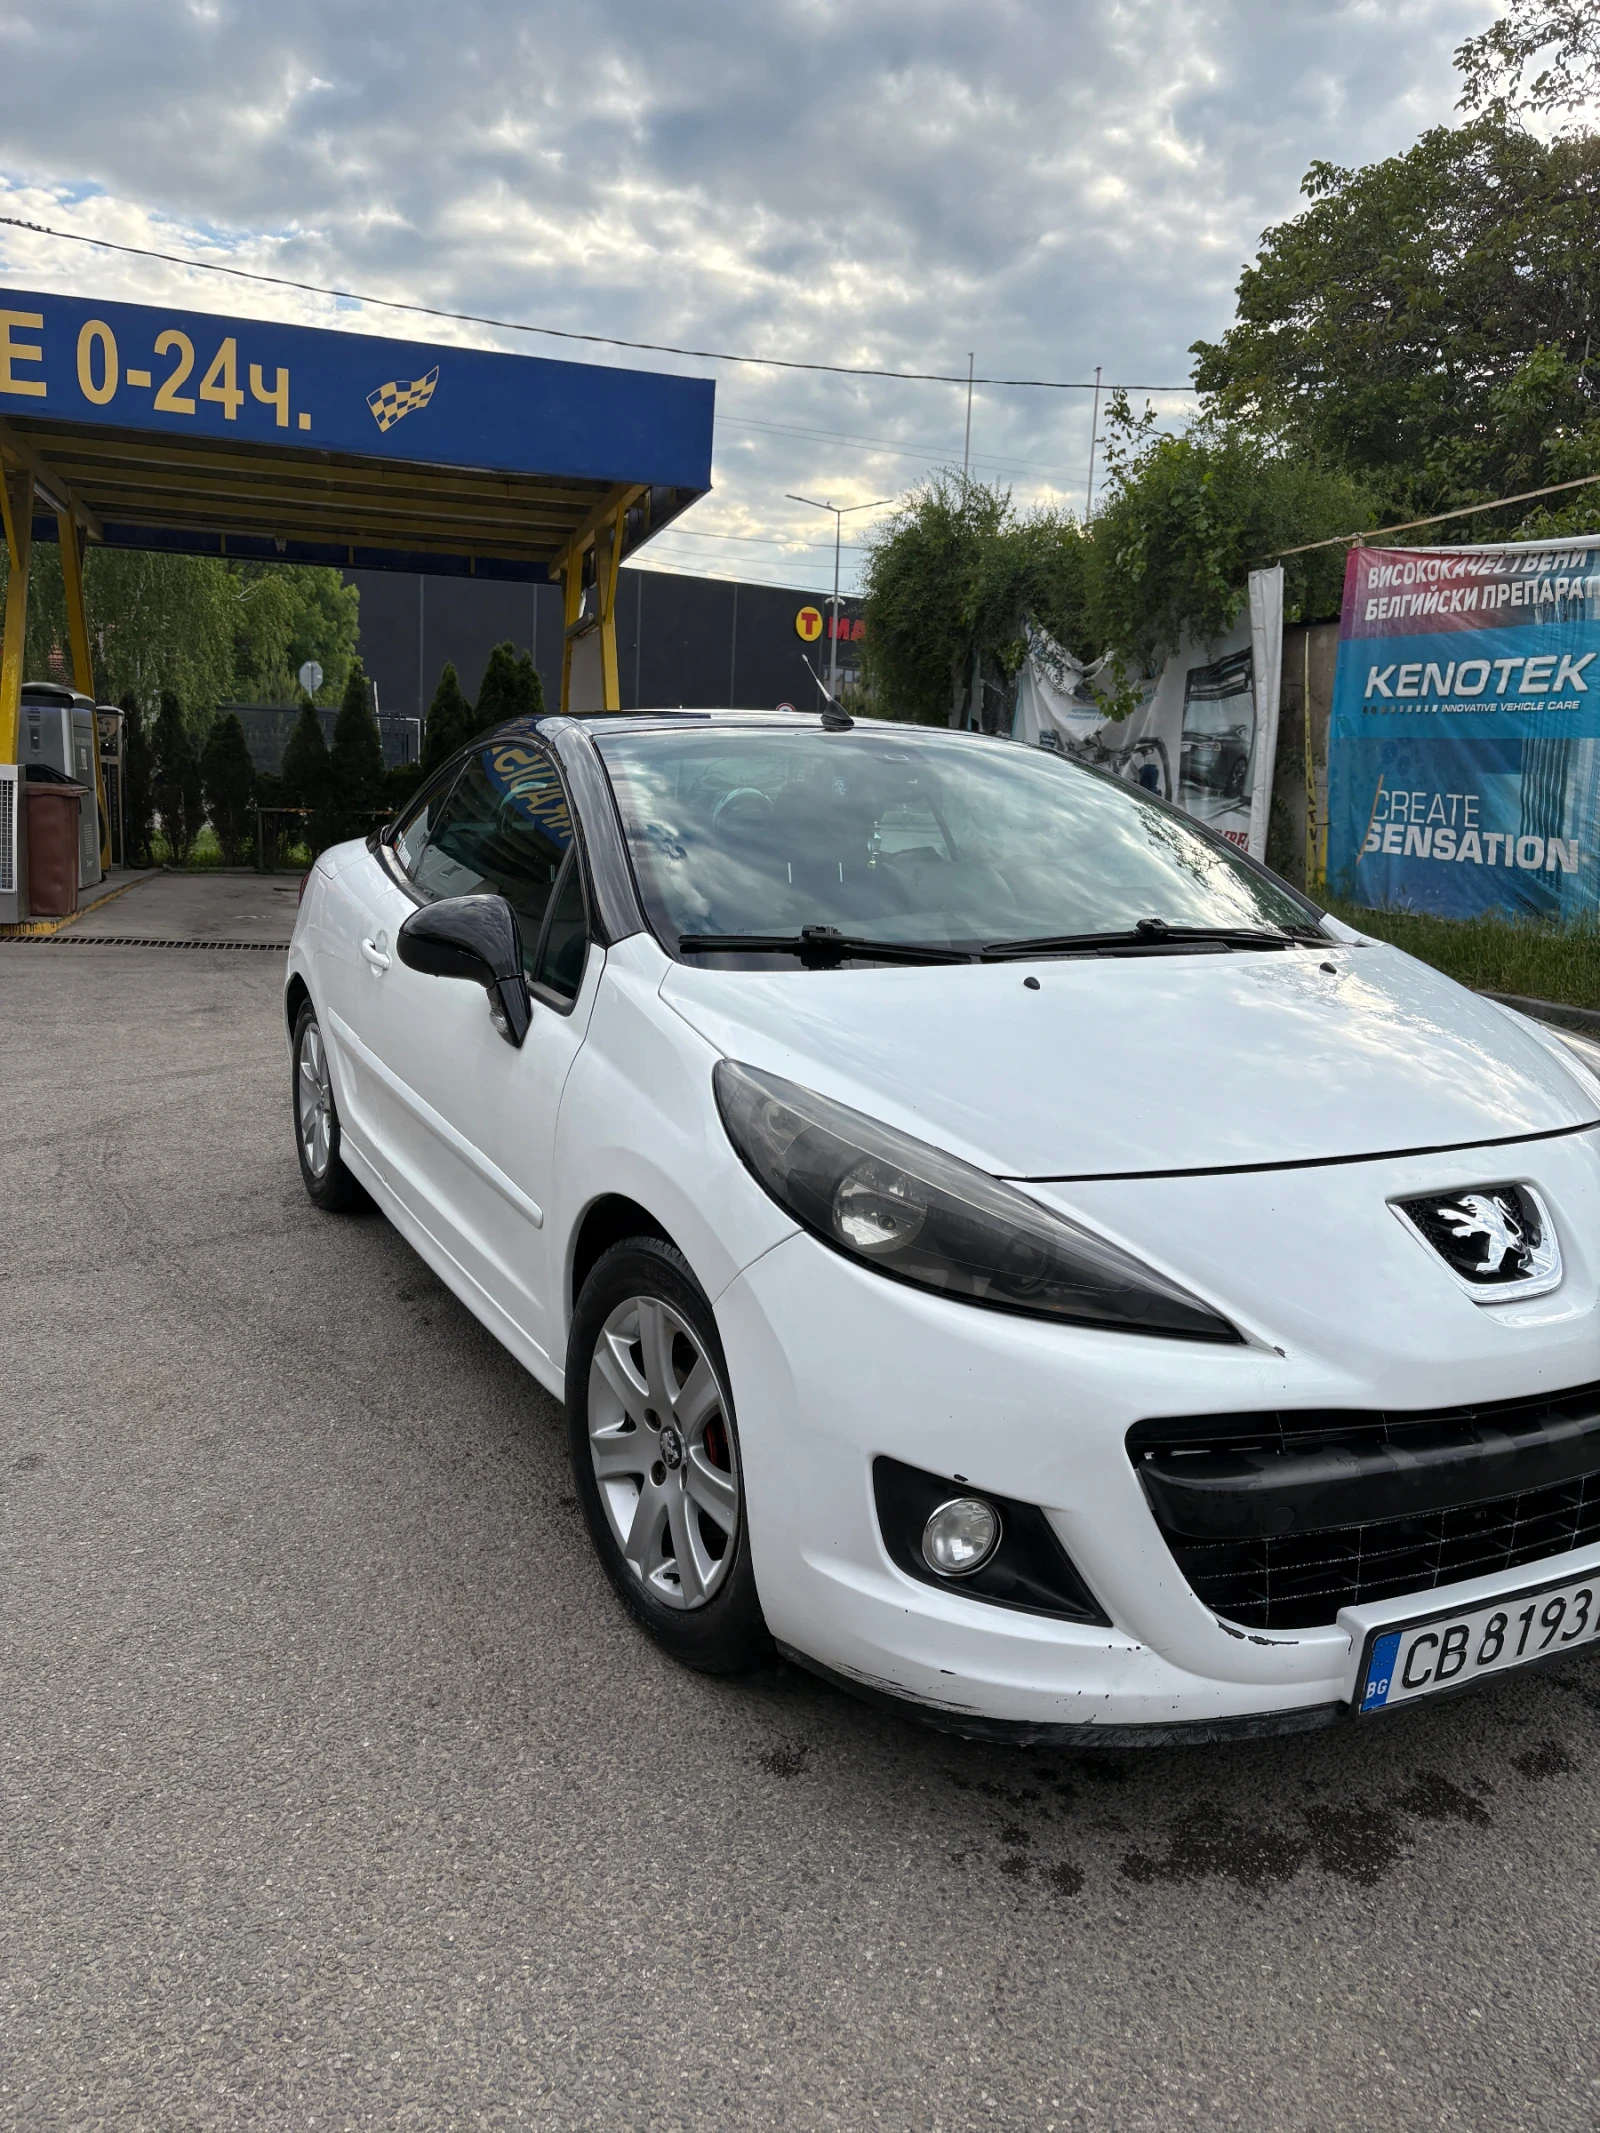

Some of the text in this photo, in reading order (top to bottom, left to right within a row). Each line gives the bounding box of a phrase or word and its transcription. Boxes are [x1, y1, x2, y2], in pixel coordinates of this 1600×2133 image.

[1367, 550, 1588, 589] ВИСОКОКАЧЕСТВЕНИ
[1365, 586, 1479, 621] БЕЛГИЙСКИ
[801, 612, 868, 640] T MA
[1365, 652, 1597, 698] KENOTEK
[1441, 700, 1580, 713] INNOVATIVE VEHICLE CARE
[1372, 790, 1480, 828] CREATE
[1363, 822, 1579, 874] SENSATION
[1366, 1678, 1388, 1698] BG
